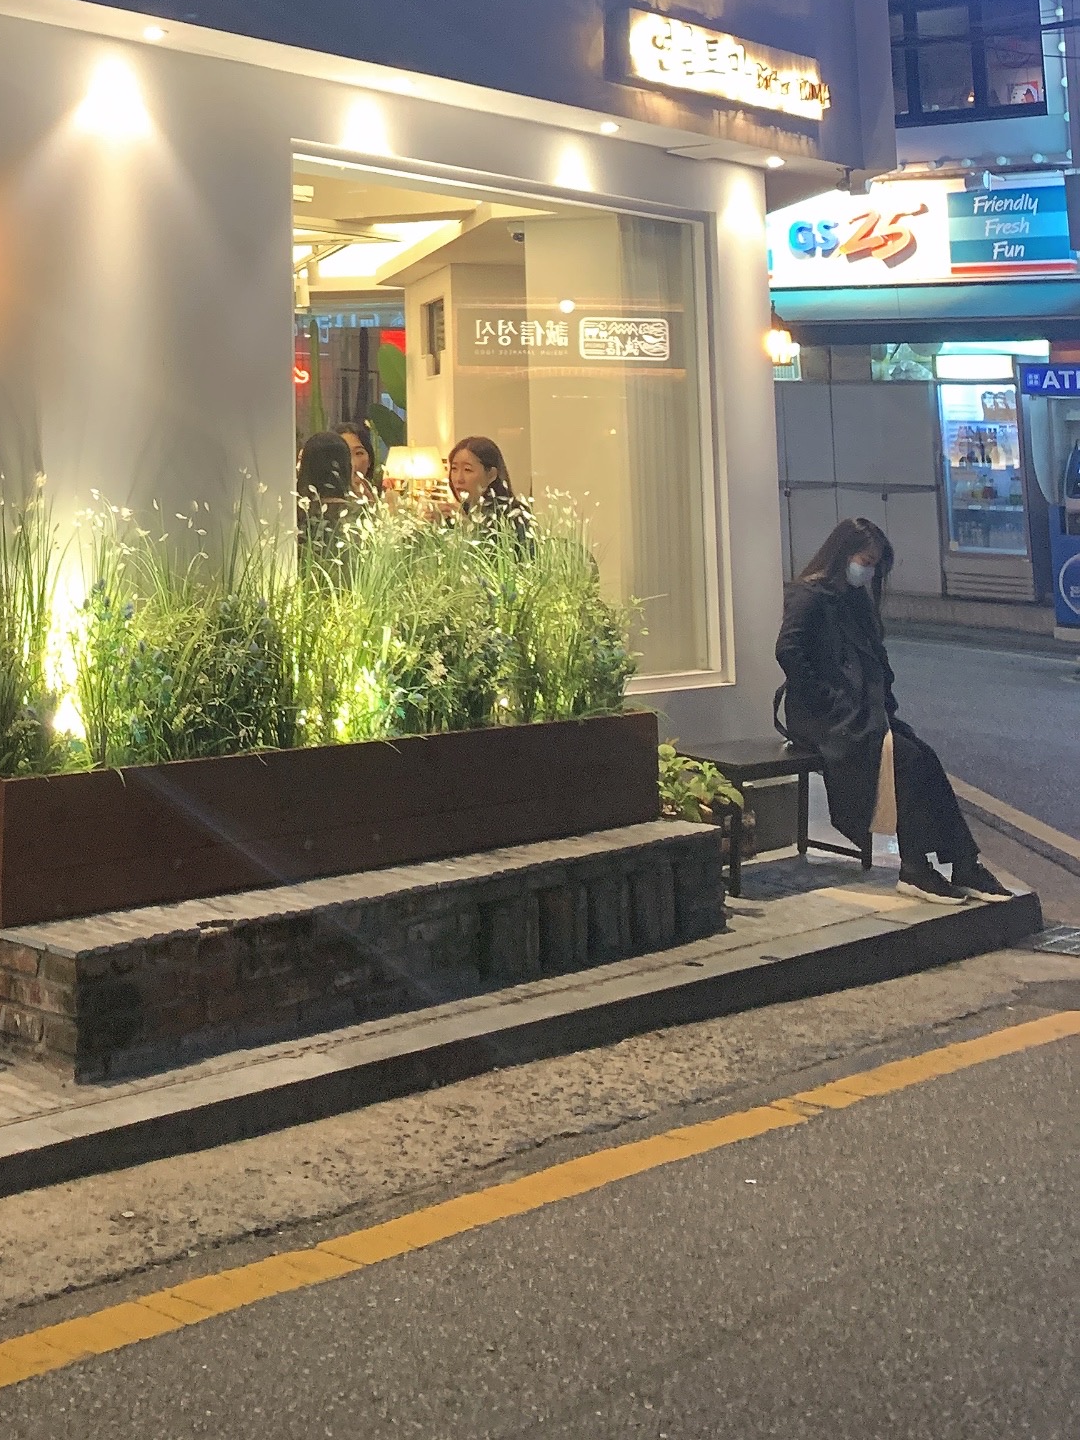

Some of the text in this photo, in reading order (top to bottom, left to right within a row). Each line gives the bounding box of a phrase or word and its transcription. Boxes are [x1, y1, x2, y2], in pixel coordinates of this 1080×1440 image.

[973, 193, 1039, 215] Friendly
[788, 202, 929, 269] GS25
[985, 219, 1030, 237] Fresh
[992, 242, 1025, 260] Fun
